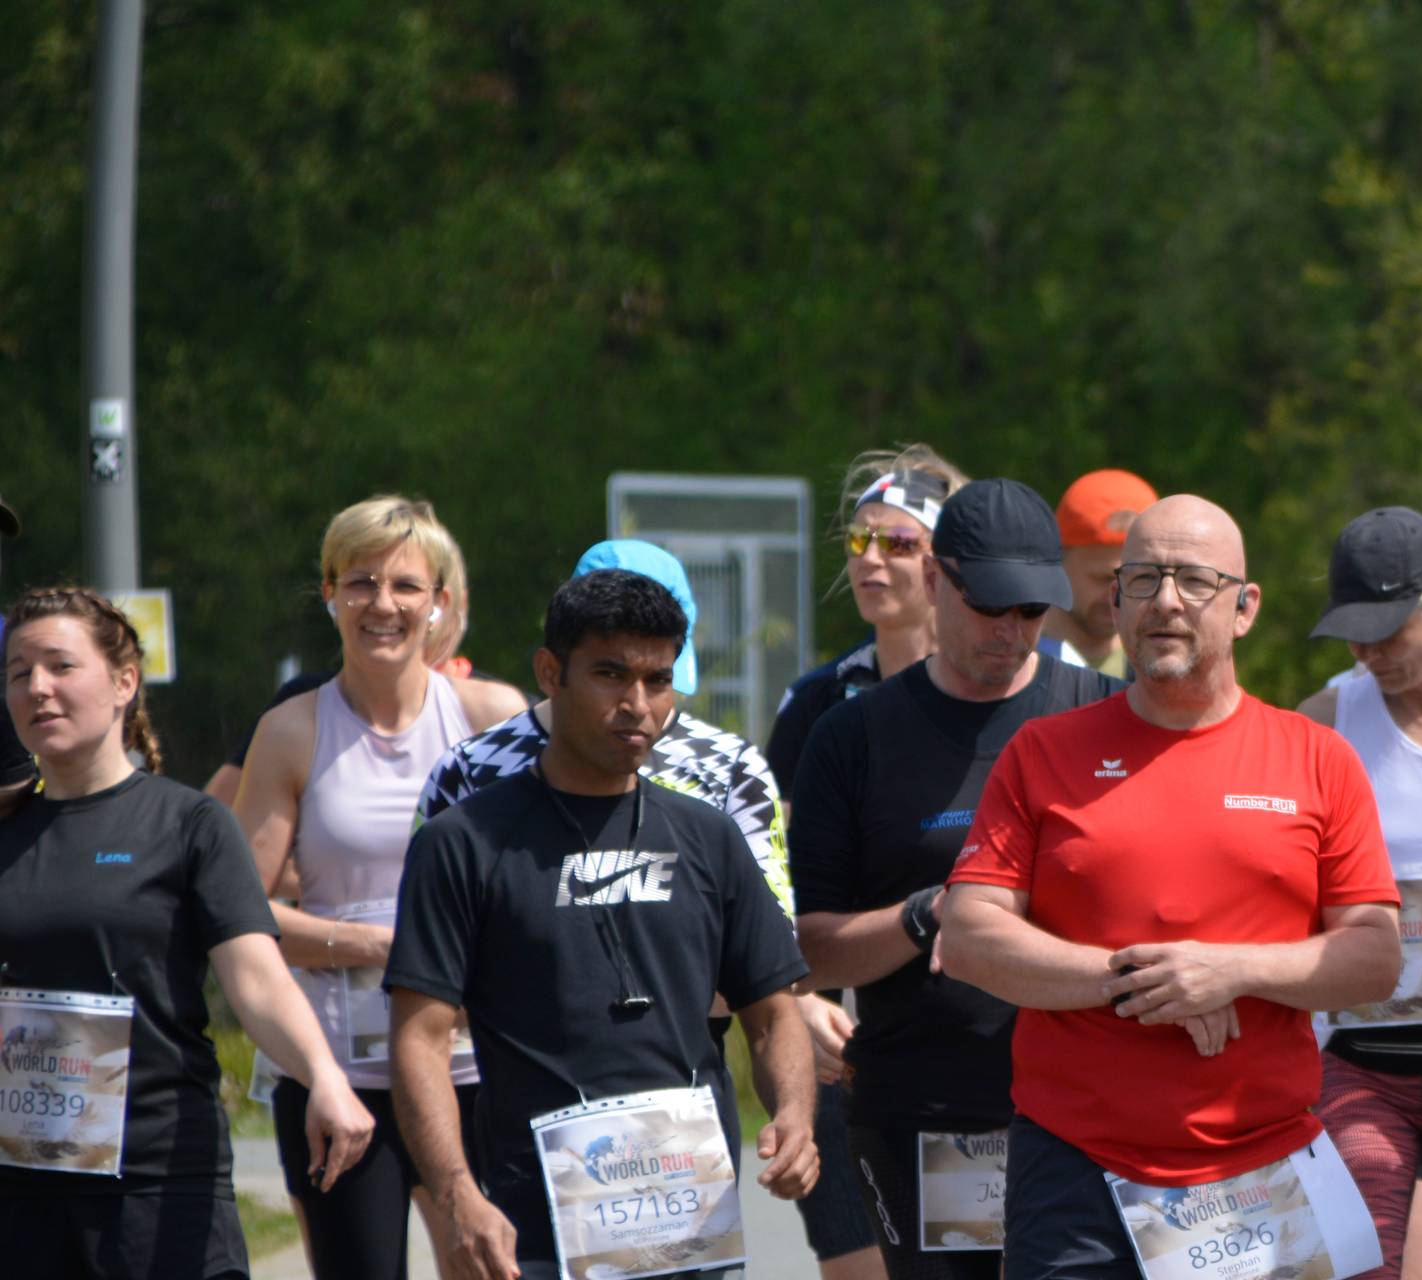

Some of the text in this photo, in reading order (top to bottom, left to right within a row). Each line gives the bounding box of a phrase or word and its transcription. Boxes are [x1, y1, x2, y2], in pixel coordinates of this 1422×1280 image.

[1094, 769, 1127, 777] erima
[1225, 797, 1297, 813] Number RUN
[95, 851, 132, 864] Lena
[555, 850, 679, 907] NIKE
[11, 1054, 57, 1074] WORLD
[602, 1156, 661, 1181] WORLD
[660, 1151, 695, 1173] RUN
[593, 1188, 701, 1227] 157163
[1181, 1194, 1238, 1226] WORLD
[1188, 1221, 1275, 1270] 83626
[1216, 1255, 1263, 1277] Stephan
